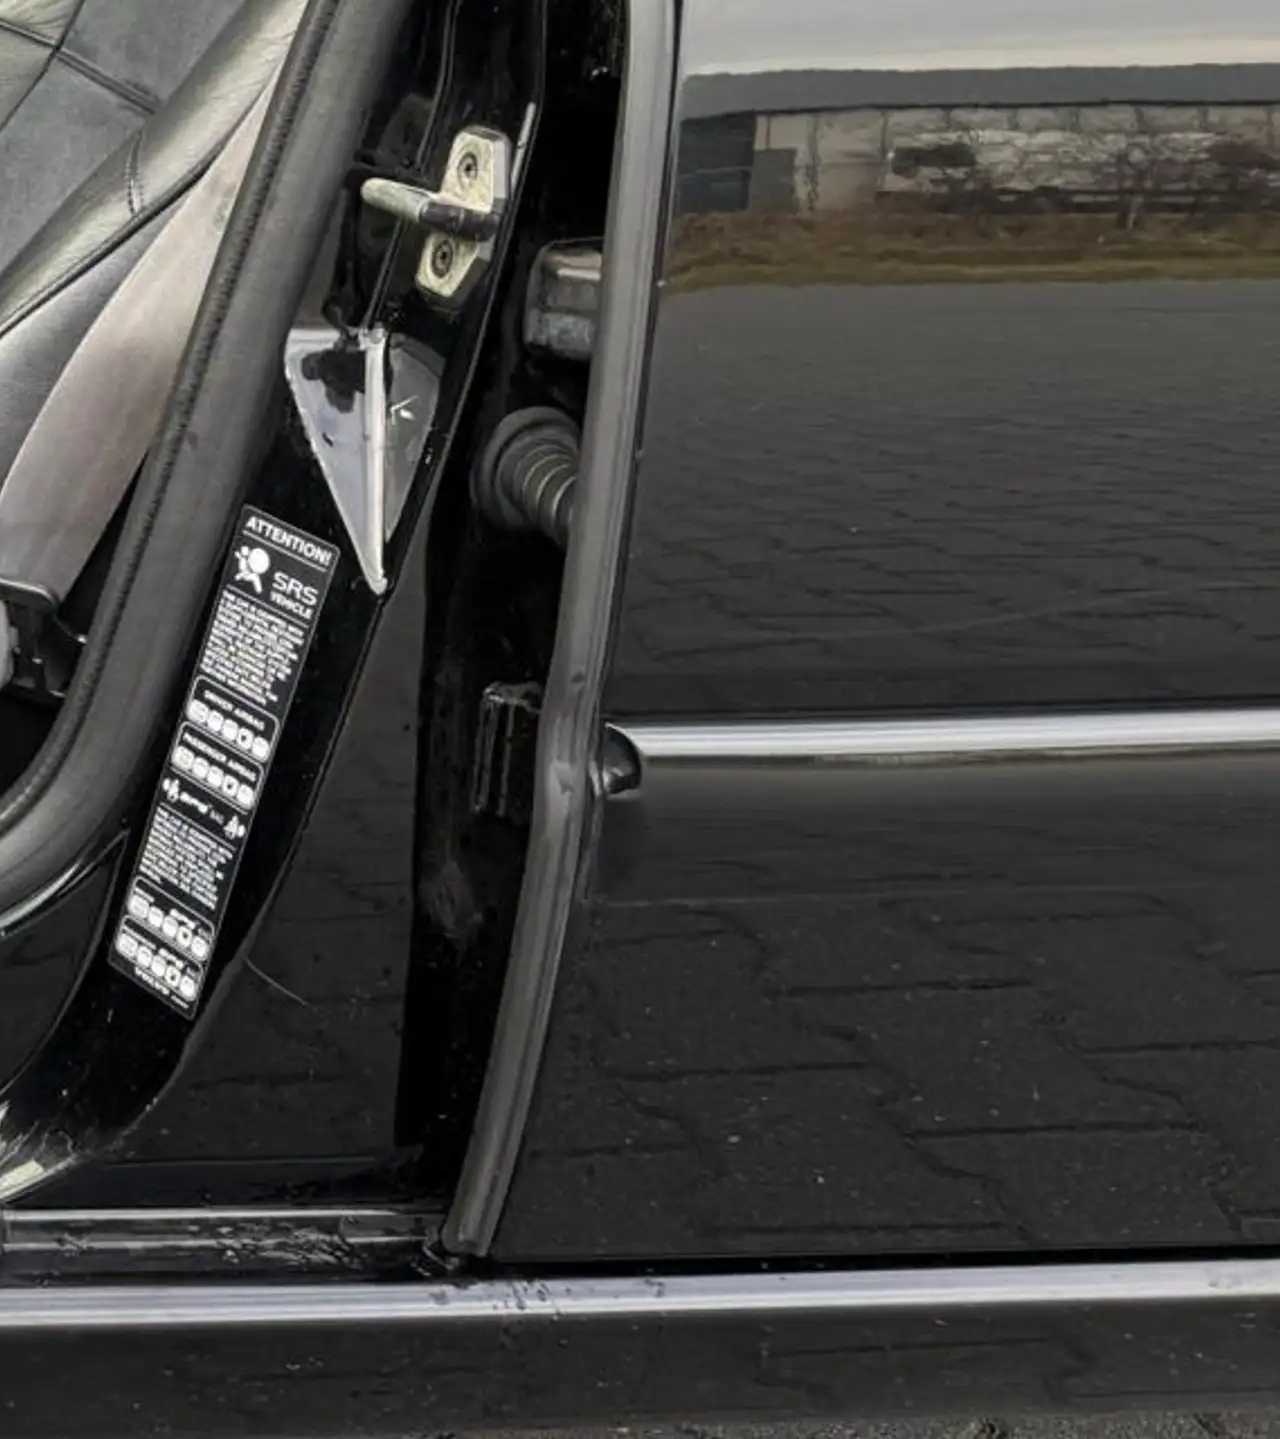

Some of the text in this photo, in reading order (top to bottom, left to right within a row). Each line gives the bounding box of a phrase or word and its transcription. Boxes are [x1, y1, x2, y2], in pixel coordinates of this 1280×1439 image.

[244, 516, 333, 566] ATTENTION!
[269, 590, 314, 620] VEHICLE
[271, 571, 319, 606] SRS
